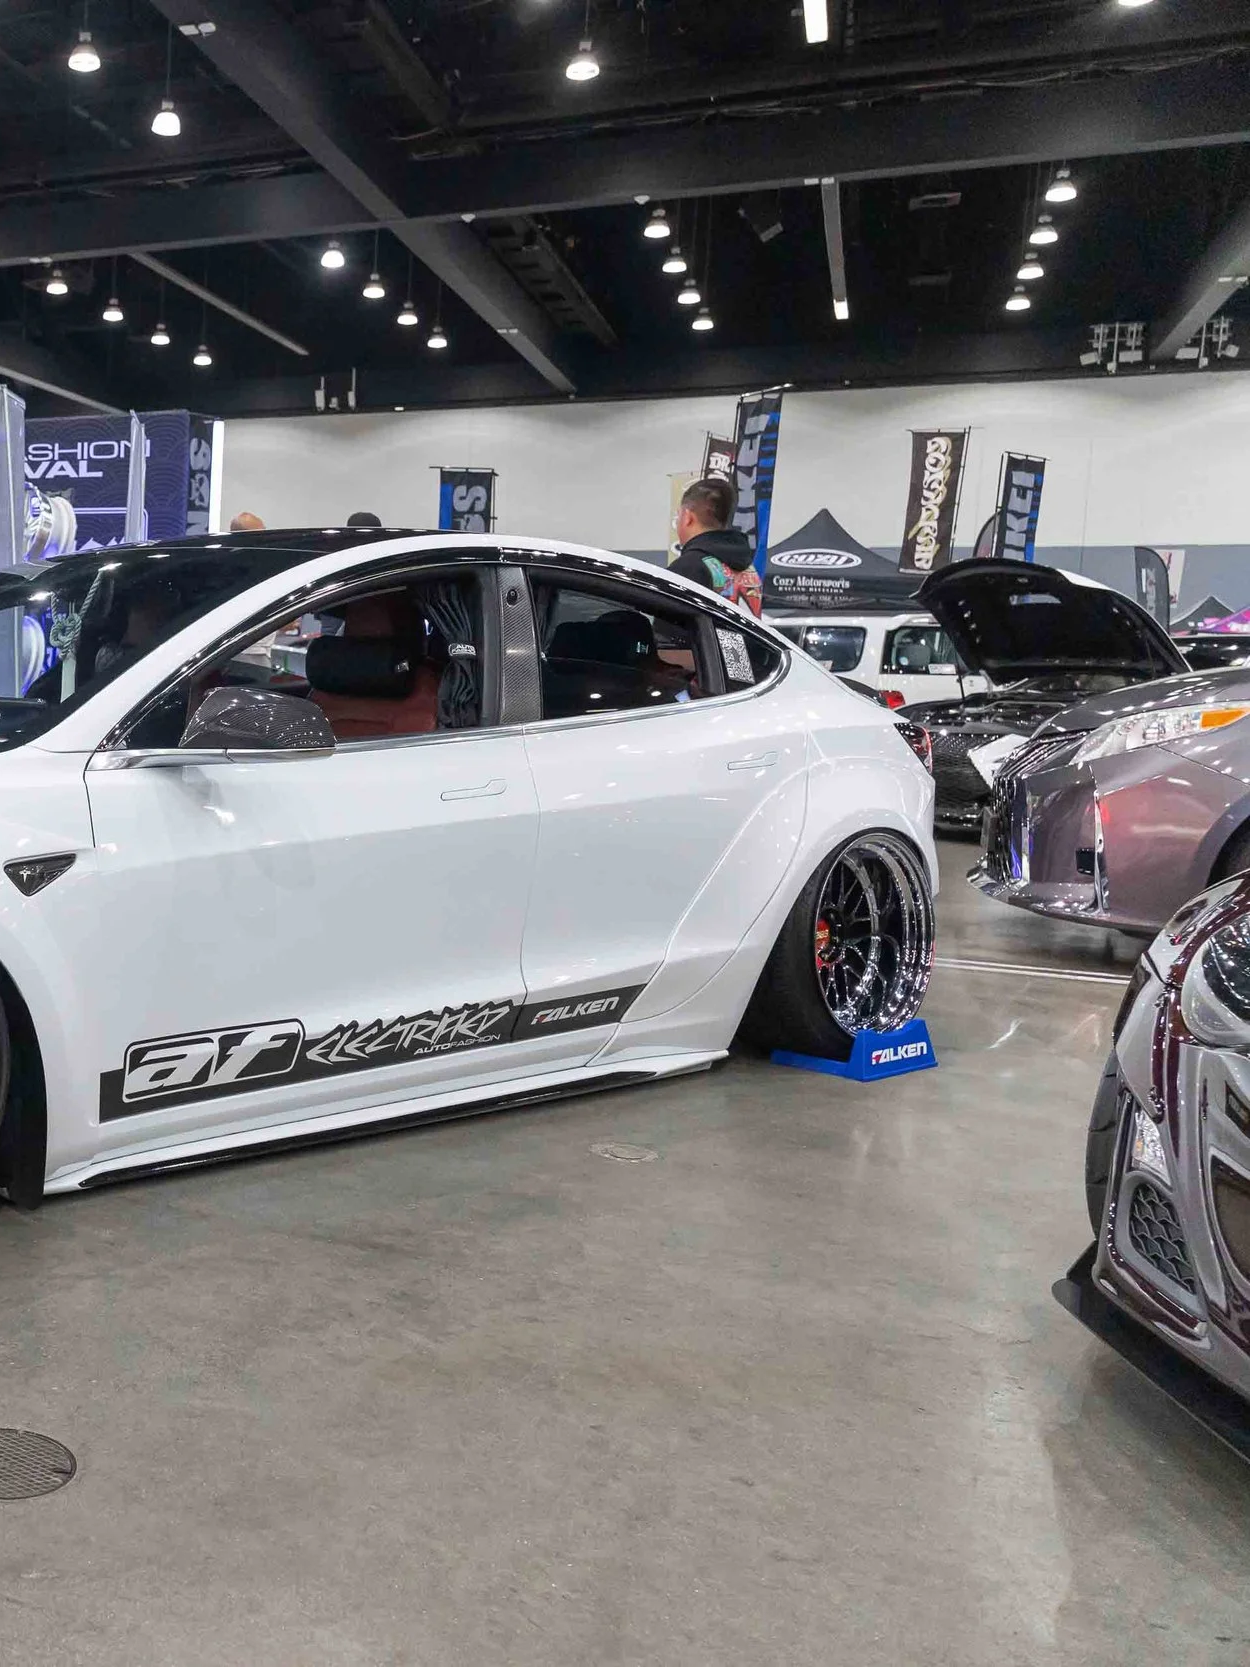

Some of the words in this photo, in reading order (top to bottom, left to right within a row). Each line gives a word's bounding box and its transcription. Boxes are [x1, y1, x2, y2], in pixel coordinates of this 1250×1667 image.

[773, 575, 795, 586] Cozy
[796, 576, 850, 589] Motorsports
[531, 996, 620, 1025] FALKEN
[414, 1023, 501, 1056] AUTOFASHION
[871, 1041, 928, 1065] FALKEN
